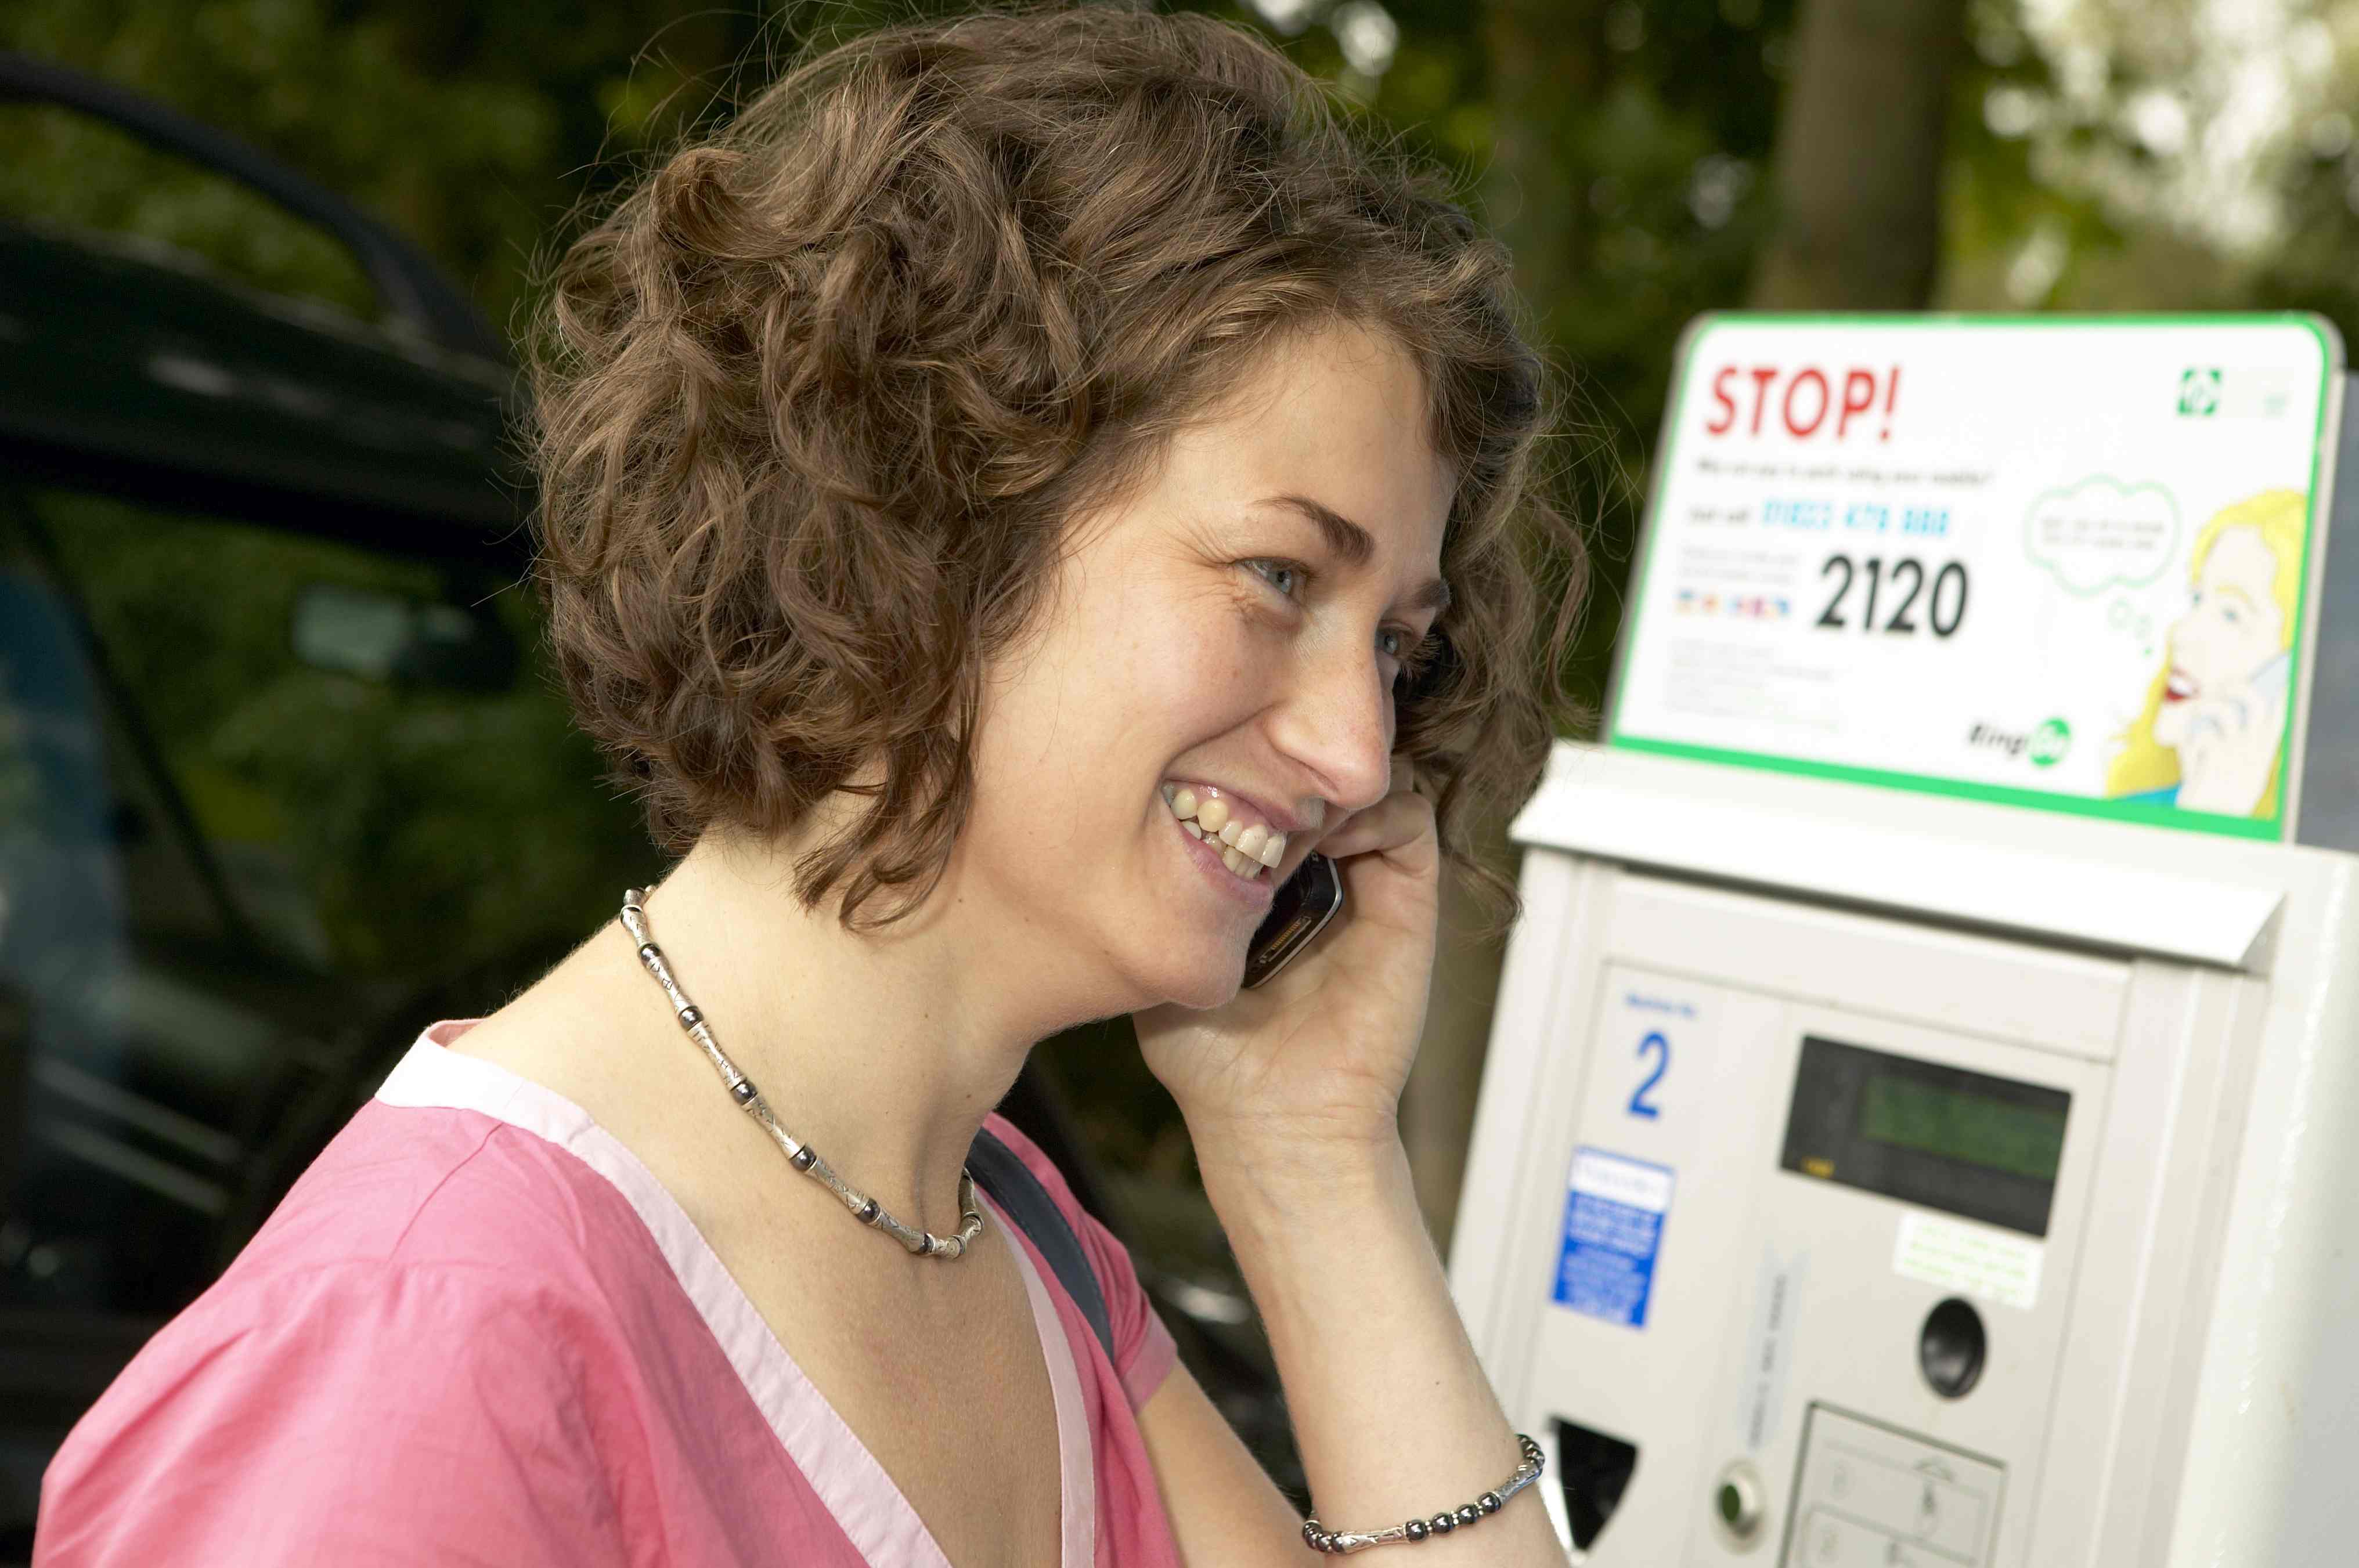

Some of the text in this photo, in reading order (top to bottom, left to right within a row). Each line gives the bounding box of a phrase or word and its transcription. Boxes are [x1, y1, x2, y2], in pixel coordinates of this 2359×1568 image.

[1706, 365, 1900, 440] STOP!
[1814, 554, 1968, 639] 2120
[1626, 1032, 1669, 1119] 2
